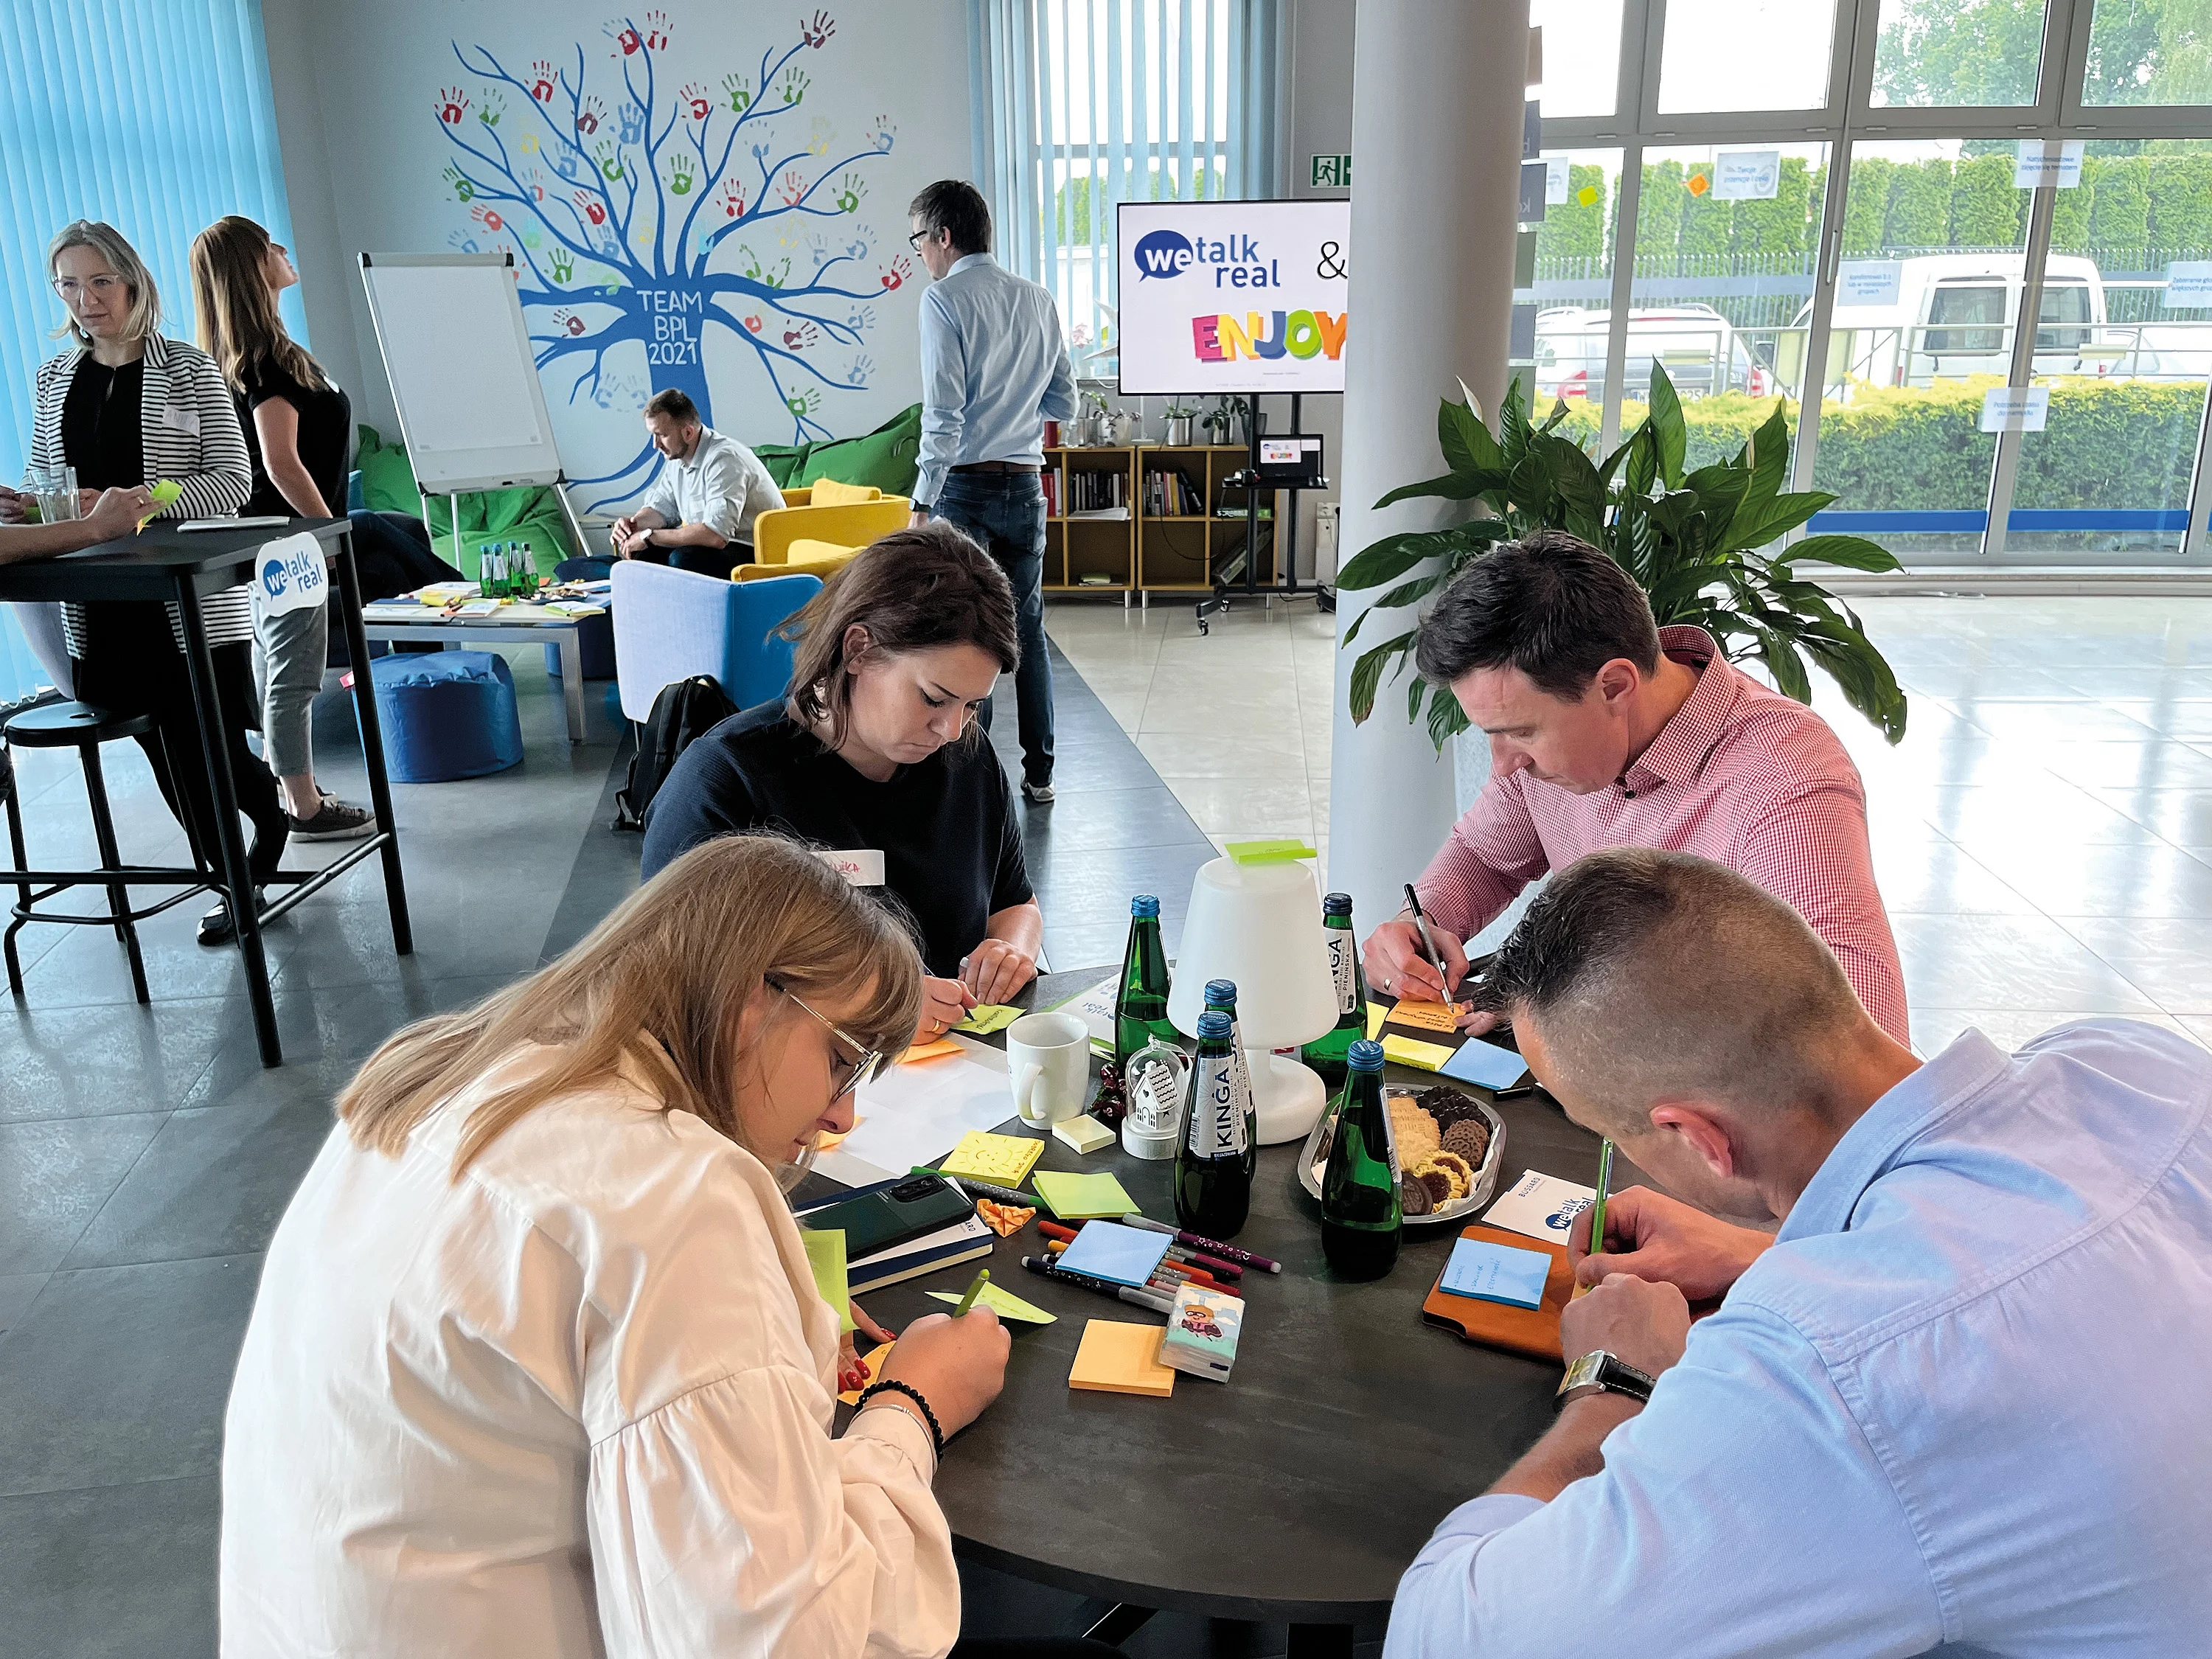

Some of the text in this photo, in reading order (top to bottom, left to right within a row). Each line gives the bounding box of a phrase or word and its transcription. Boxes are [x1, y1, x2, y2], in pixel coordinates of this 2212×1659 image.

[1216, 259, 1281, 288] real
[1317, 241, 1348, 279] &
[636, 290, 702, 314] TEAM
[654, 315, 698, 342] BPL
[1192, 309, 1347, 364] ENJOY
[648, 341, 697, 364] 2021
[298, 563, 322, 593] real
[1215, 1066, 1233, 1148] KINGA
[1518, 1177, 1540, 1197] BOSSARD
